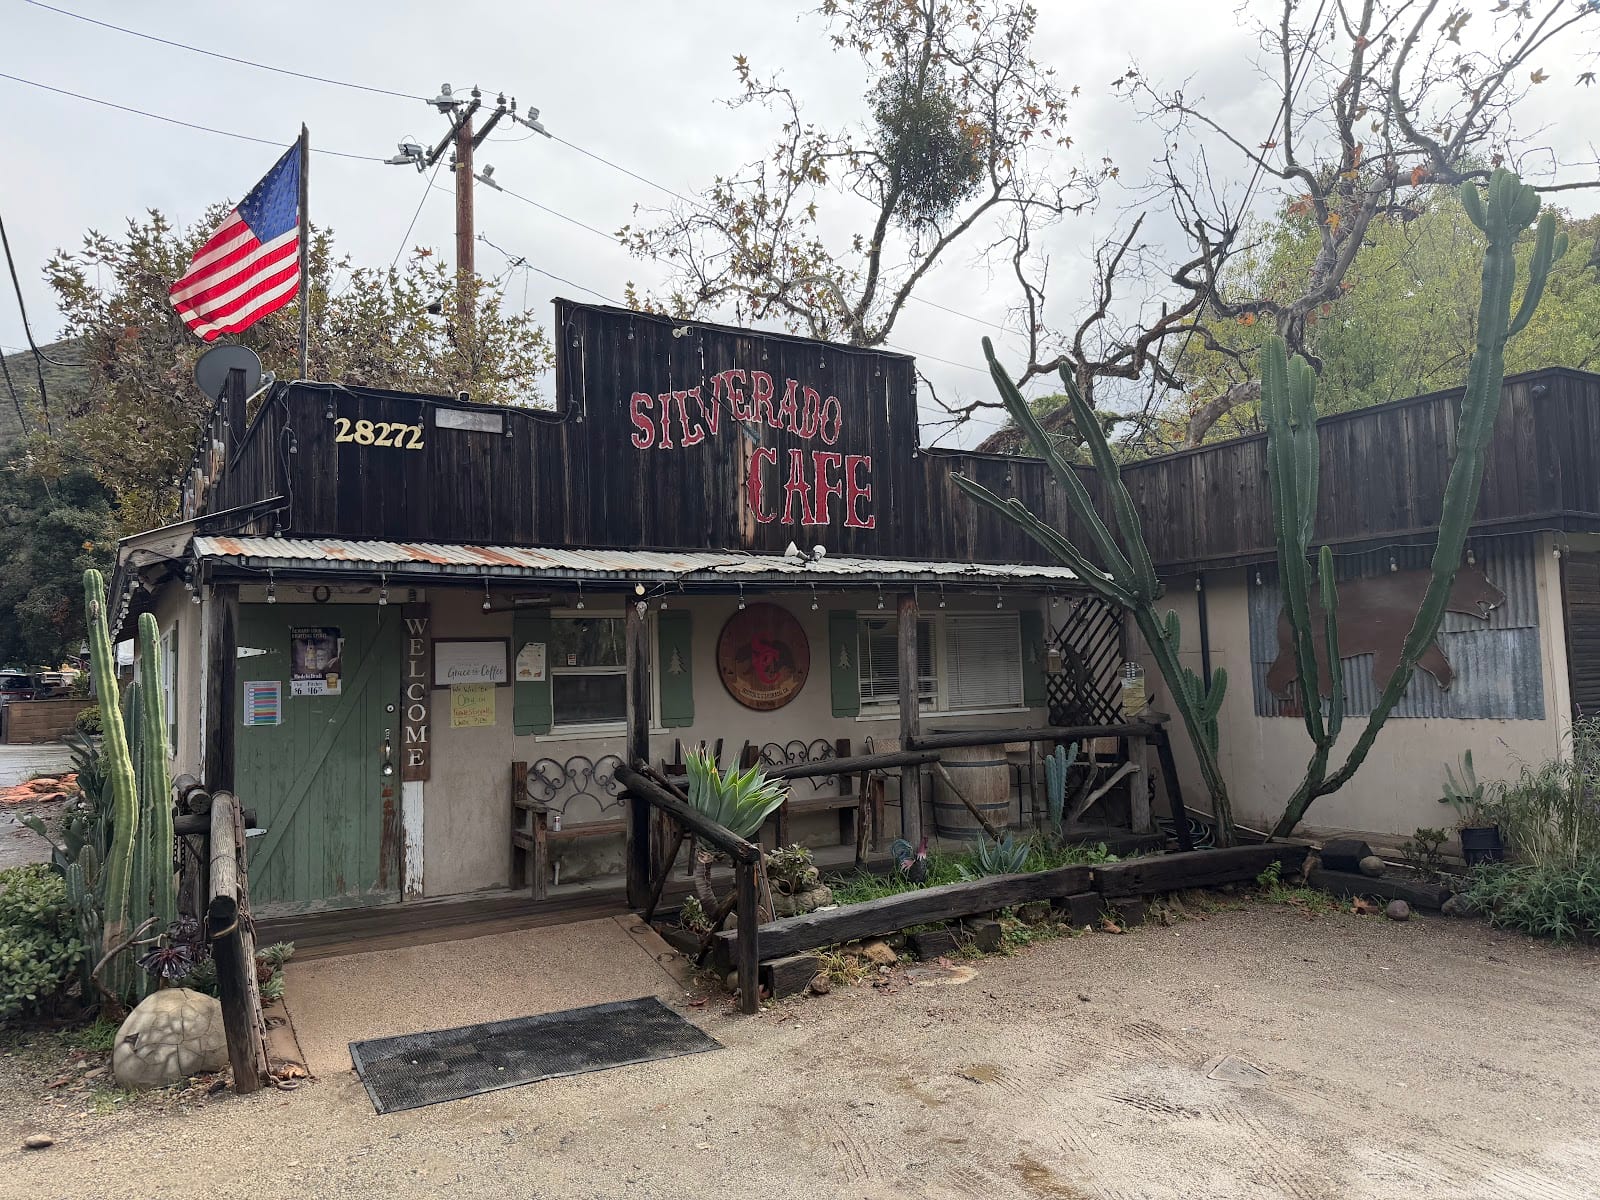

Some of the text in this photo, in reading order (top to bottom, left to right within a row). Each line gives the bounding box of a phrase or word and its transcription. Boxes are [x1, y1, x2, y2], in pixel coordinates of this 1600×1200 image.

[333, 417, 425, 450] 28272
[629, 369, 842, 449] SILVERADO
[746, 447, 875, 529] CAFE
[404, 618, 428, 767] WELCOME
[480, 664, 503, 680] Coffee
